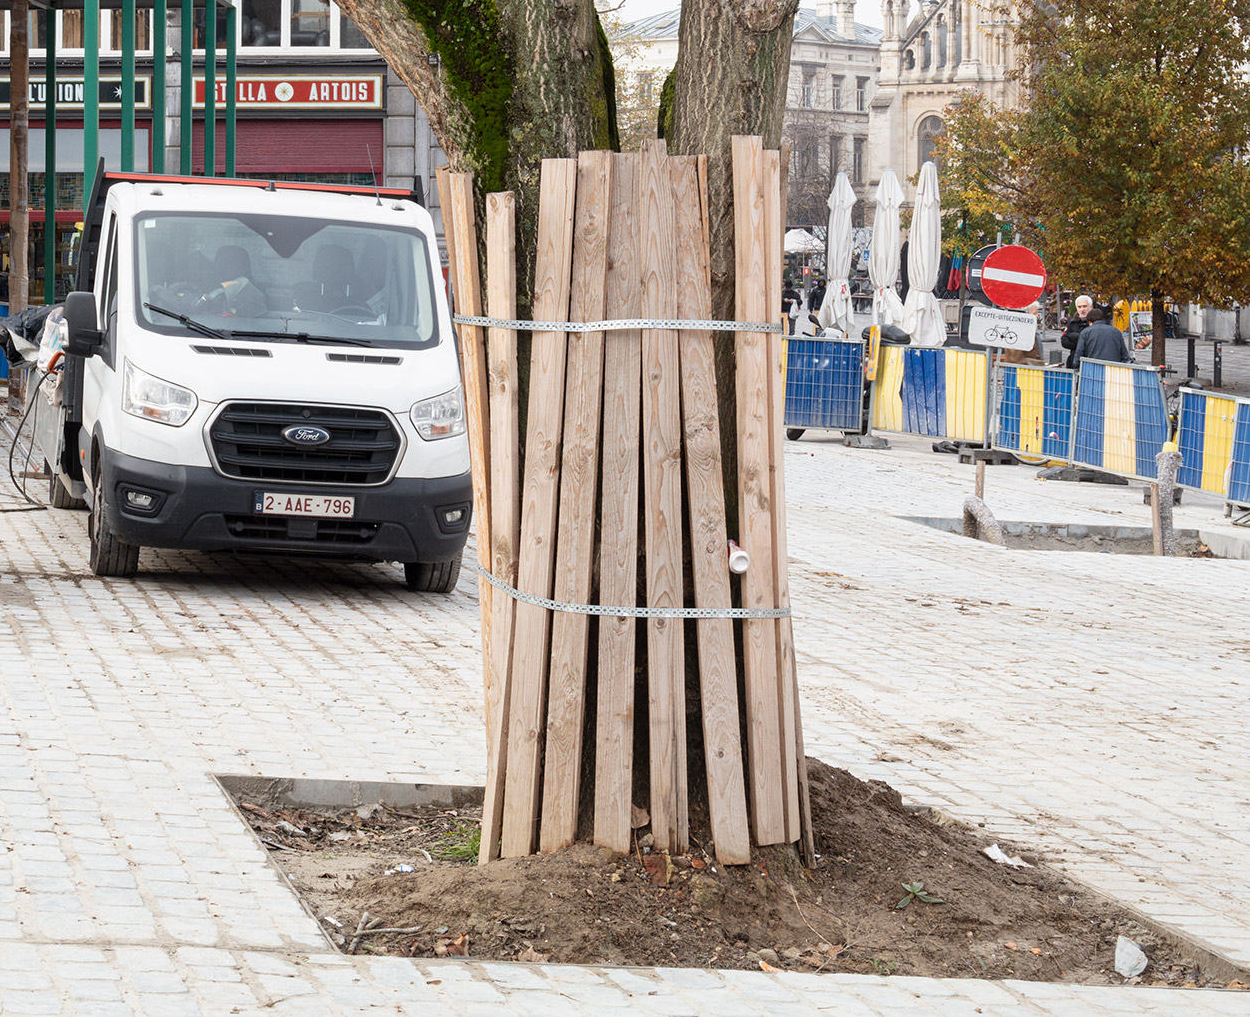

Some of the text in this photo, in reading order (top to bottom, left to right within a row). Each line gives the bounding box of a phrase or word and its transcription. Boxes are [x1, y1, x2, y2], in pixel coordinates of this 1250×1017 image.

[28, 84, 84, 102] L'UION
[309, 83, 368, 101] ARTOIS
[295, 429, 320, 441] Ford
[265, 496, 352, 515] 2-AAE-796
